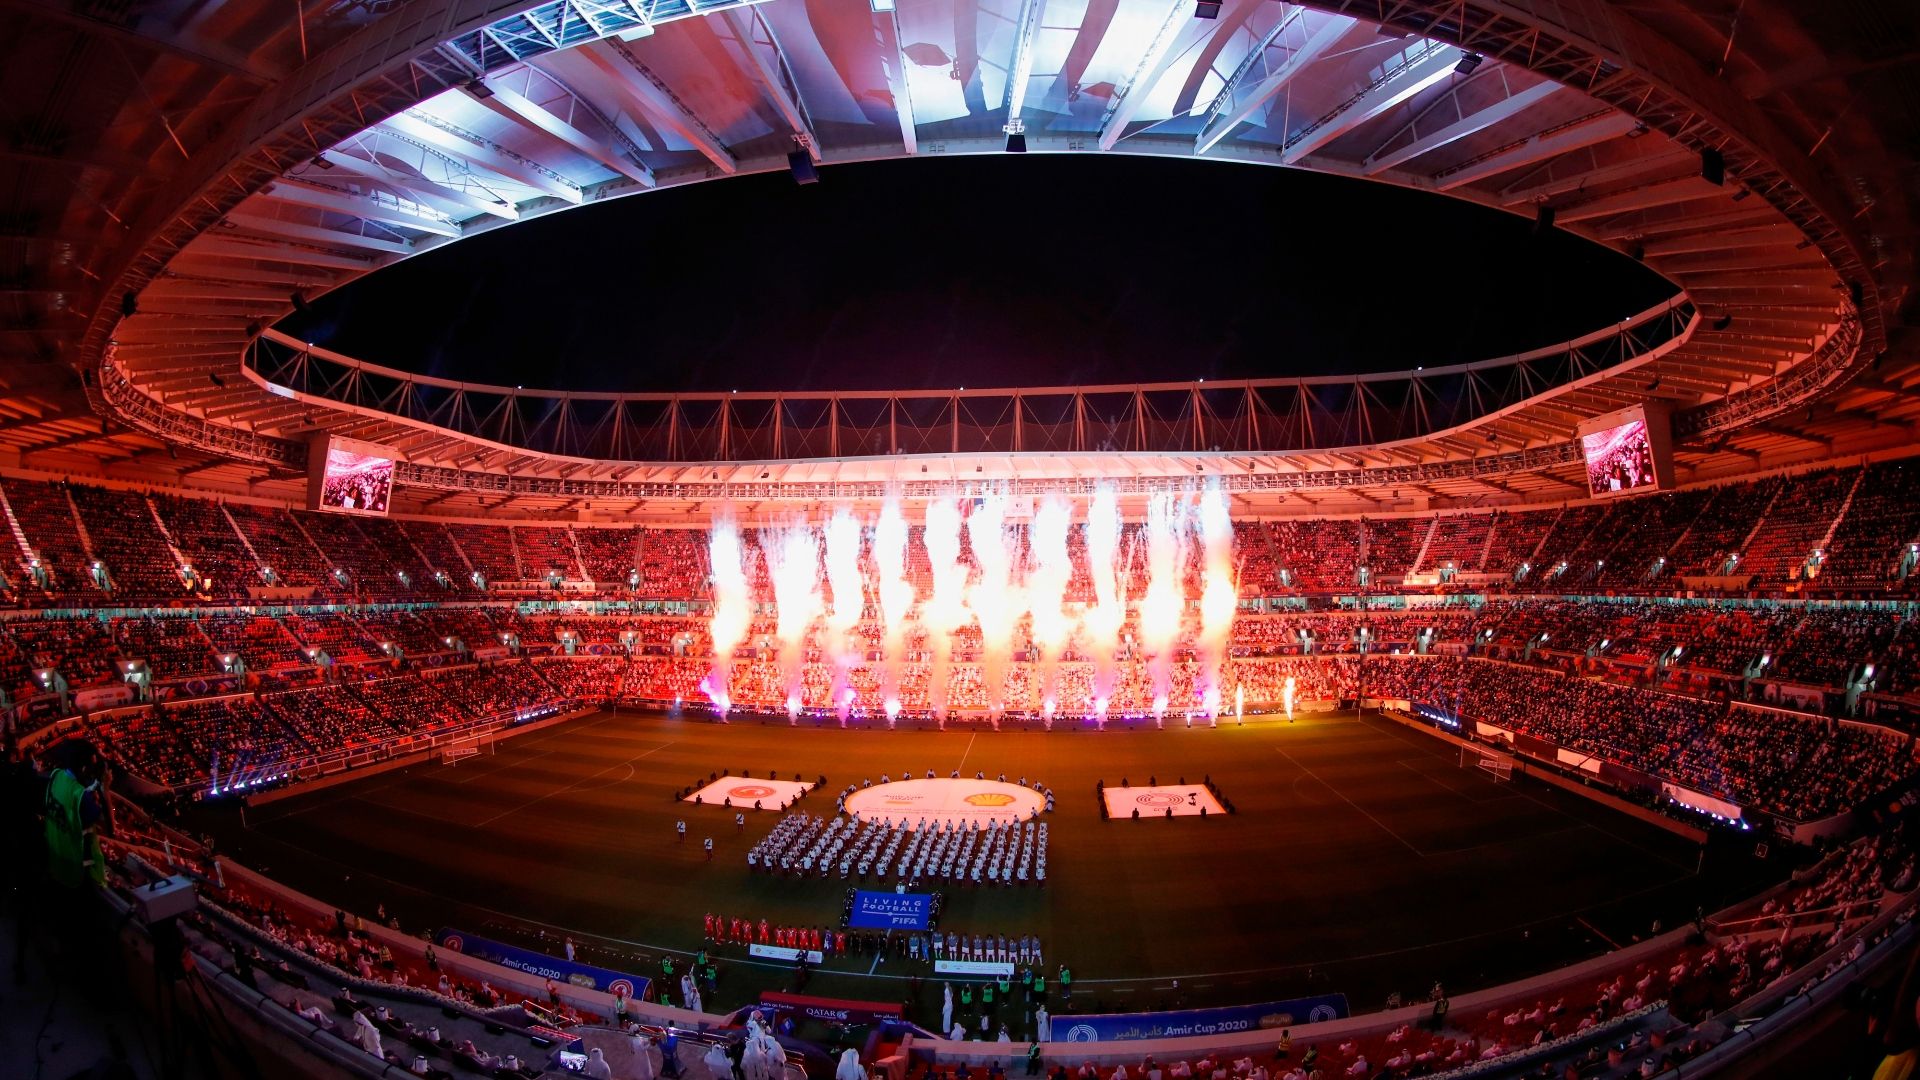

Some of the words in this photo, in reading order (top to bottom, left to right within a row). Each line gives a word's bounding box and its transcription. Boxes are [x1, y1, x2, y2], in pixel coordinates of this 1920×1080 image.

[862, 903, 920, 912] FOOTBALL
[864, 897, 921, 907] LIVING
[892, 917, 917, 925] FIFA
[501, 957, 521, 969] Amir
[522, 962, 538, 975] Cup
[537, 967, 560, 980] 2020
[806, 1007, 836, 1017] QATAR
[1114, 1026, 1140, 1040] الأمير
[1140, 1025, 1163, 1039] كأس
[1164, 1025, 1192, 1035] Amir
[1195, 1023, 1216, 1034] Cup
[1217, 1020, 1248, 1031] 2020
